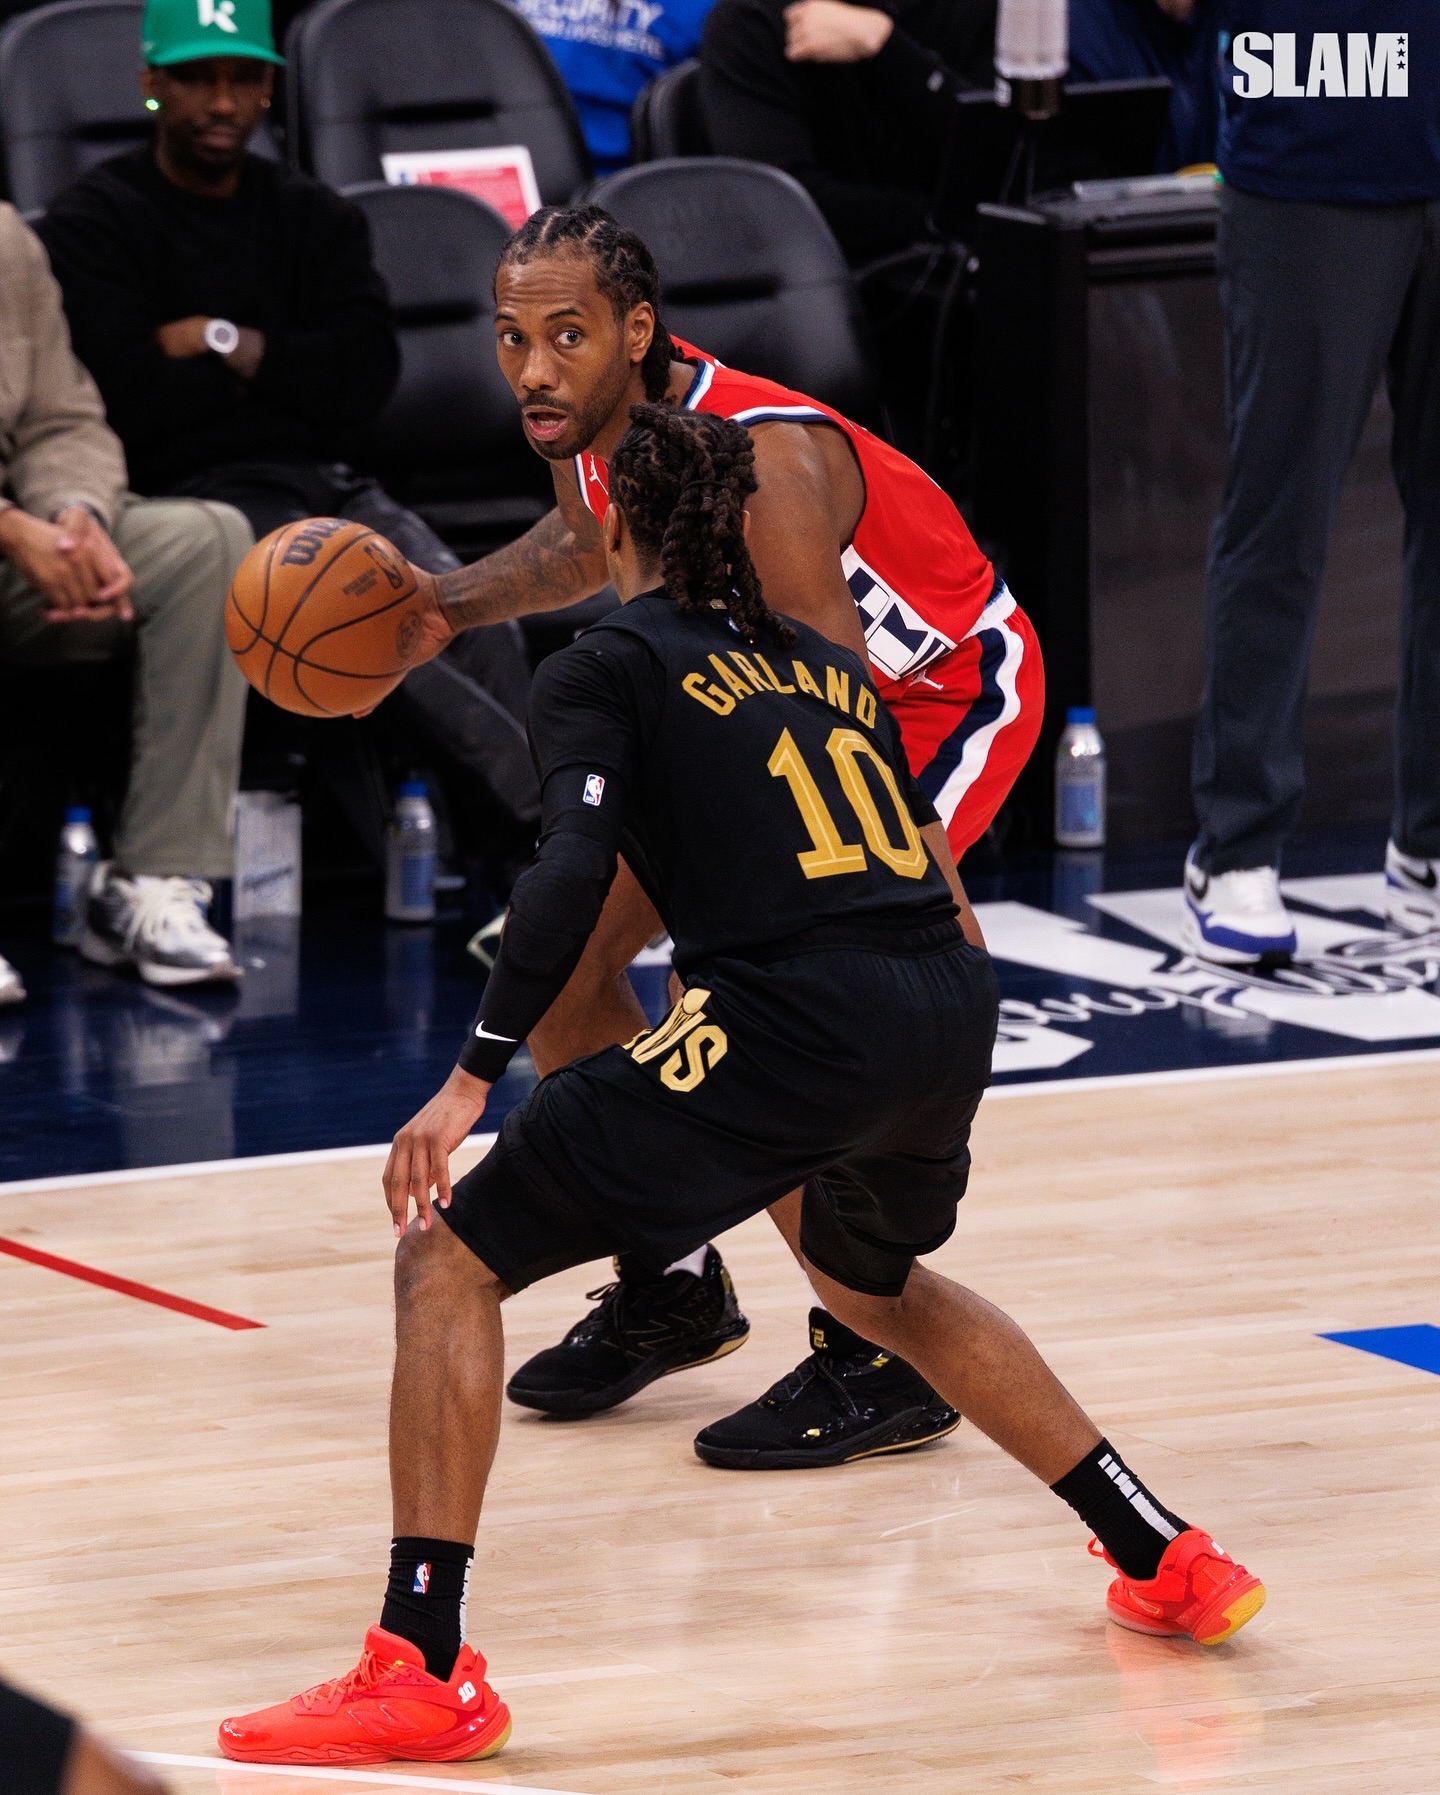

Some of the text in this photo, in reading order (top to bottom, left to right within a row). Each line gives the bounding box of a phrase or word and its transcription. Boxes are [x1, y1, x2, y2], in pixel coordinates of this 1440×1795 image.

[682, 651, 877, 729] GARLAND
[767, 727, 929, 880] 10
[458, 1681, 476, 1704] 10
